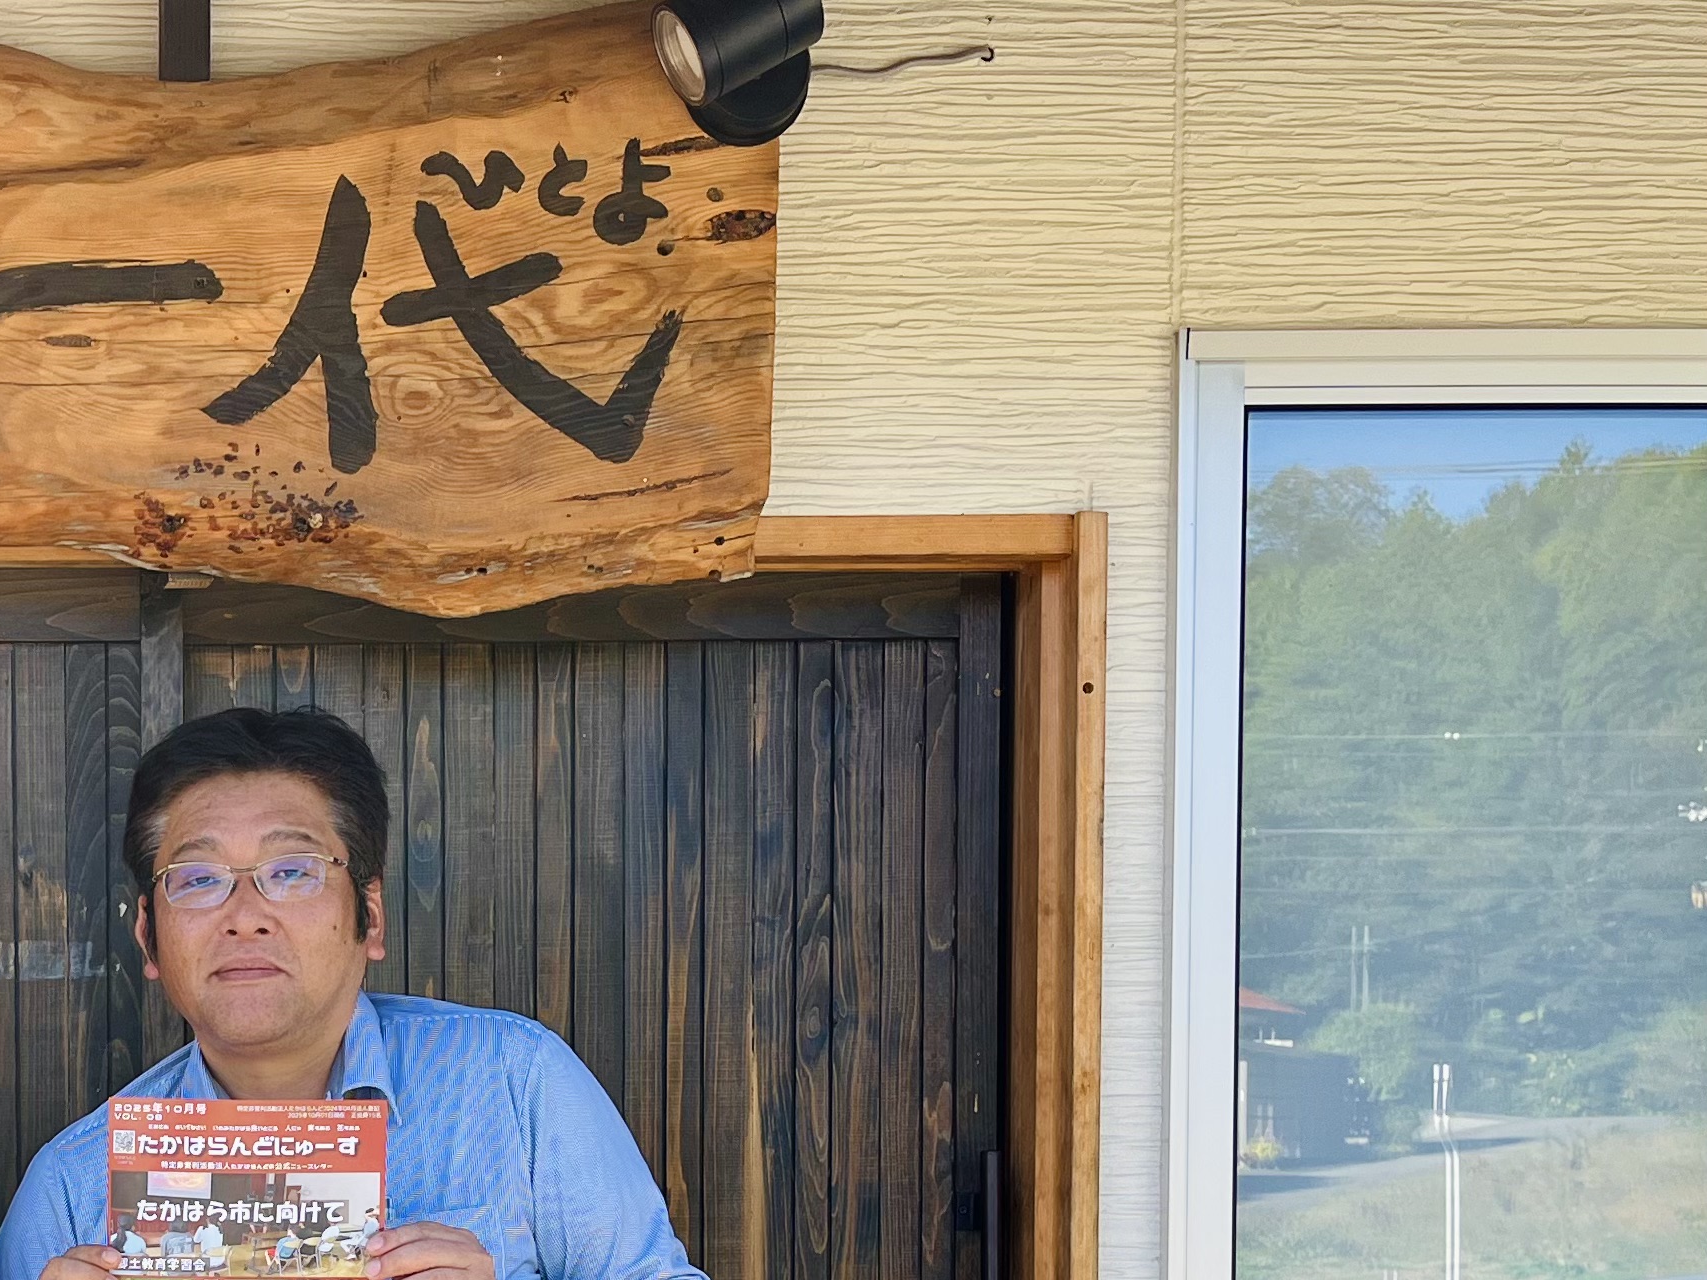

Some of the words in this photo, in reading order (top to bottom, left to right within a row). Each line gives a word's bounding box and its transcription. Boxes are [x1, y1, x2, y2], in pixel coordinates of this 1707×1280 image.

[420, 137, 671, 245] ひとよ
[114, 1102, 207, 1115] 2025年10月号
[137, 1134, 359, 1156] たかはらんどにゅーす
[136, 1199, 345, 1223] たかはら市に向けて
